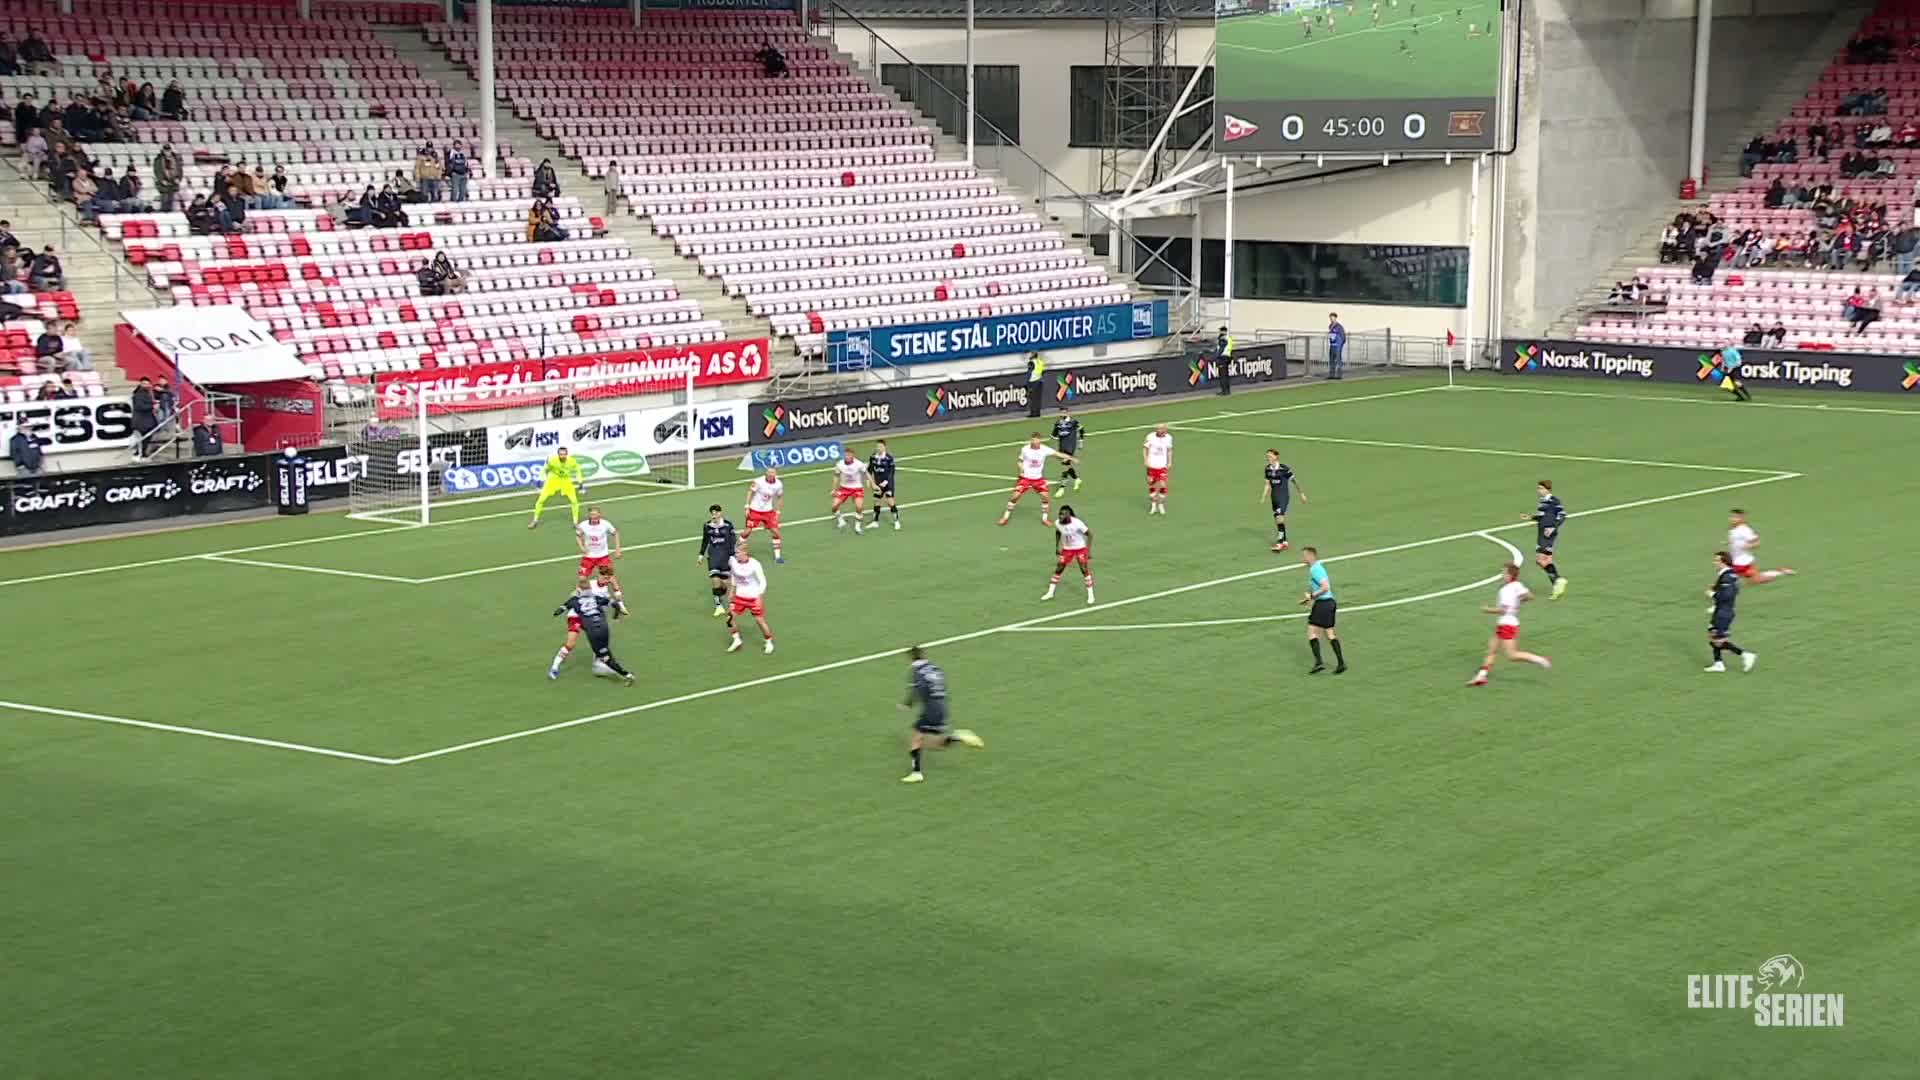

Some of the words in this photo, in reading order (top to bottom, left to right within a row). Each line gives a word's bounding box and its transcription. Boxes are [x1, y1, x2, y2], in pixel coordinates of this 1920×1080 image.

[1281, 114, 1304, 141] 0
[1322, 116, 1386, 137] 45:00
[1403, 112, 1426, 139] 0
[890, 330, 947, 358] STENE
[951, 322, 992, 352] STÅL
[995, 315, 1093, 346] PRODUKTER
[1096, 313, 1116, 335] AS
[707, 351, 736, 376] AS
[1238, 355, 1272, 378] Tipping
[1542, 350, 1588, 369] Norsk
[1592, 351, 1654, 376] Tipping
[1741, 360, 1780, 380] orsk
[1782, 361, 1852, 386] Tipping
[1076, 376, 1111, 394] Norsk
[1111, 370, 1157, 393] Tipping
[948, 388, 984, 410] Norsk
[984, 384, 1028, 407] Tipping
[700, 414, 734, 441] HSM
[788, 407, 833, 430] Norsk
[836, 402, 890, 426] Tipping
[535, 431, 559, 448] HSM
[603, 423, 626, 440] HSM
[787, 444, 840, 464] OBOS
[191, 475, 247, 494] CRAFT
[481, 463, 545, 487] OBOS
[15, 492, 78, 513] CRAFT
[105, 483, 165, 503] CRAFT
